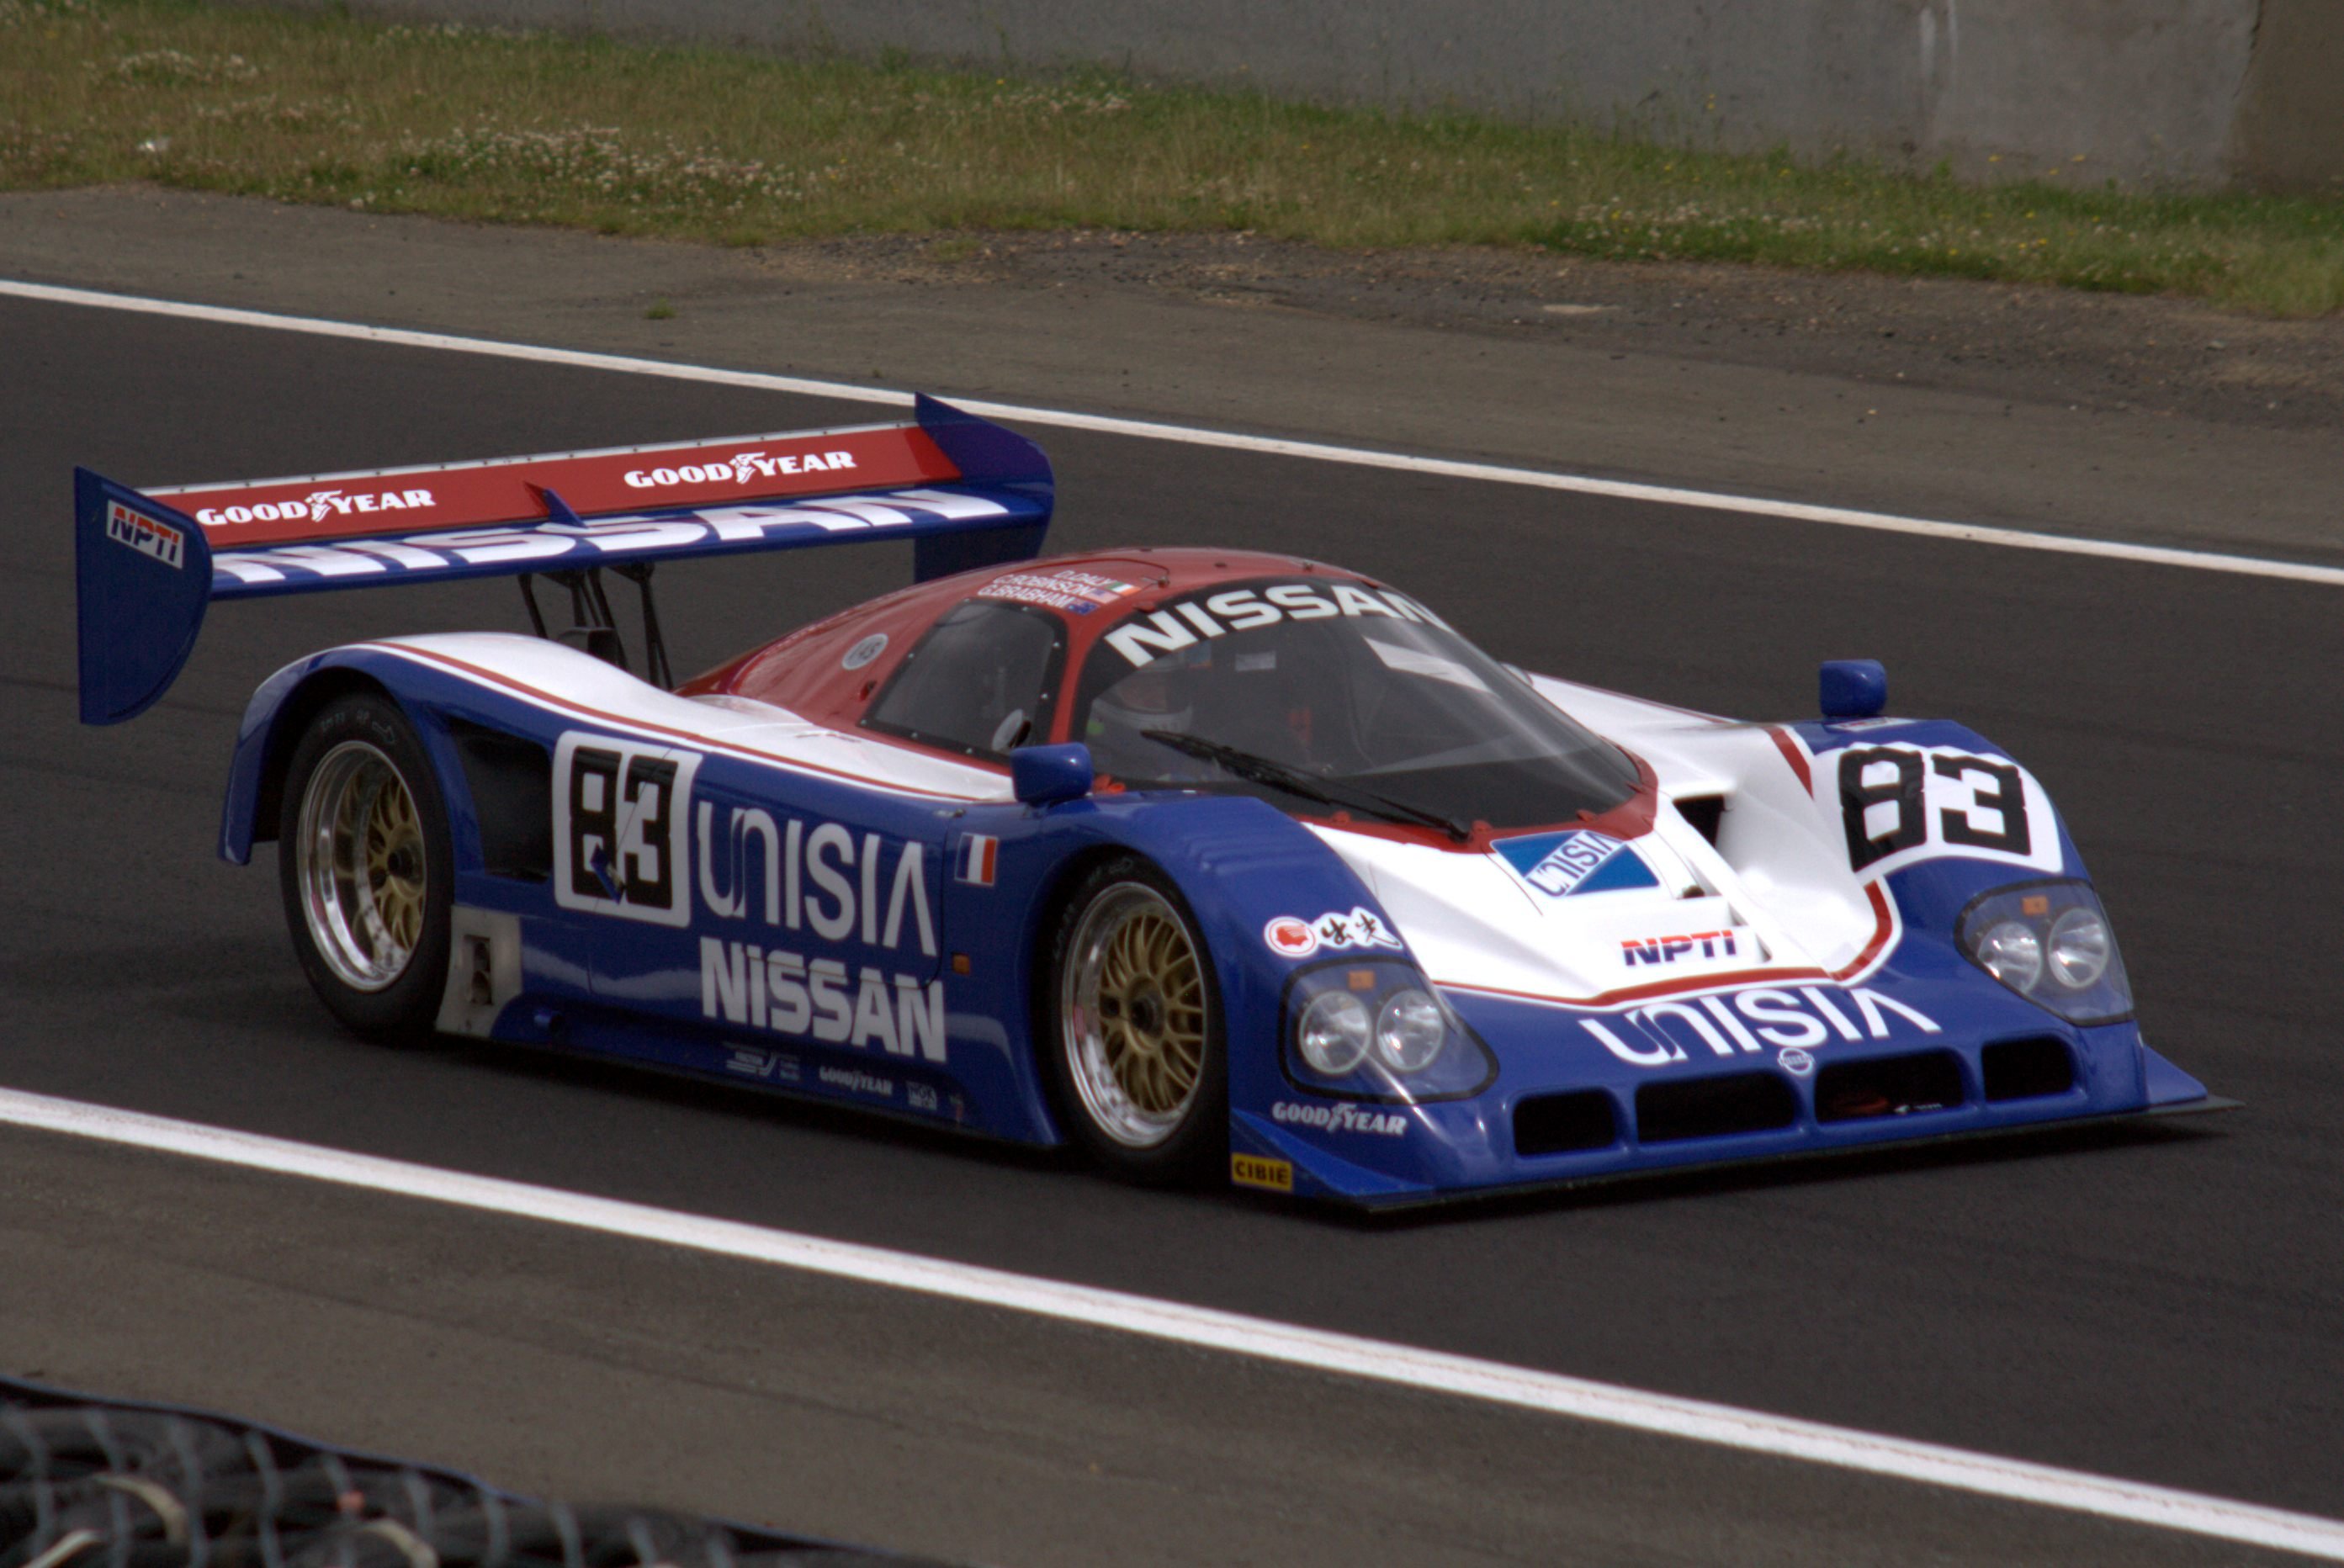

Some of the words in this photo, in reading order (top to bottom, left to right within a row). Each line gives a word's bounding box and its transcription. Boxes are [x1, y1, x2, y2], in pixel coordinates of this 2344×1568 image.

[110, 506, 181, 563] NPTI
[210, 488, 1009, 583] NISSAN
[1103, 584, 1459, 668] NISSAN
[570, 745, 678, 910] 83
[1838, 745, 2032, 874] 83
[1620, 930, 1737, 967] NPTI
[700, 935, 947, 1063] NISSAN
[1272, 1101, 1408, 1136] GOODYEAR
